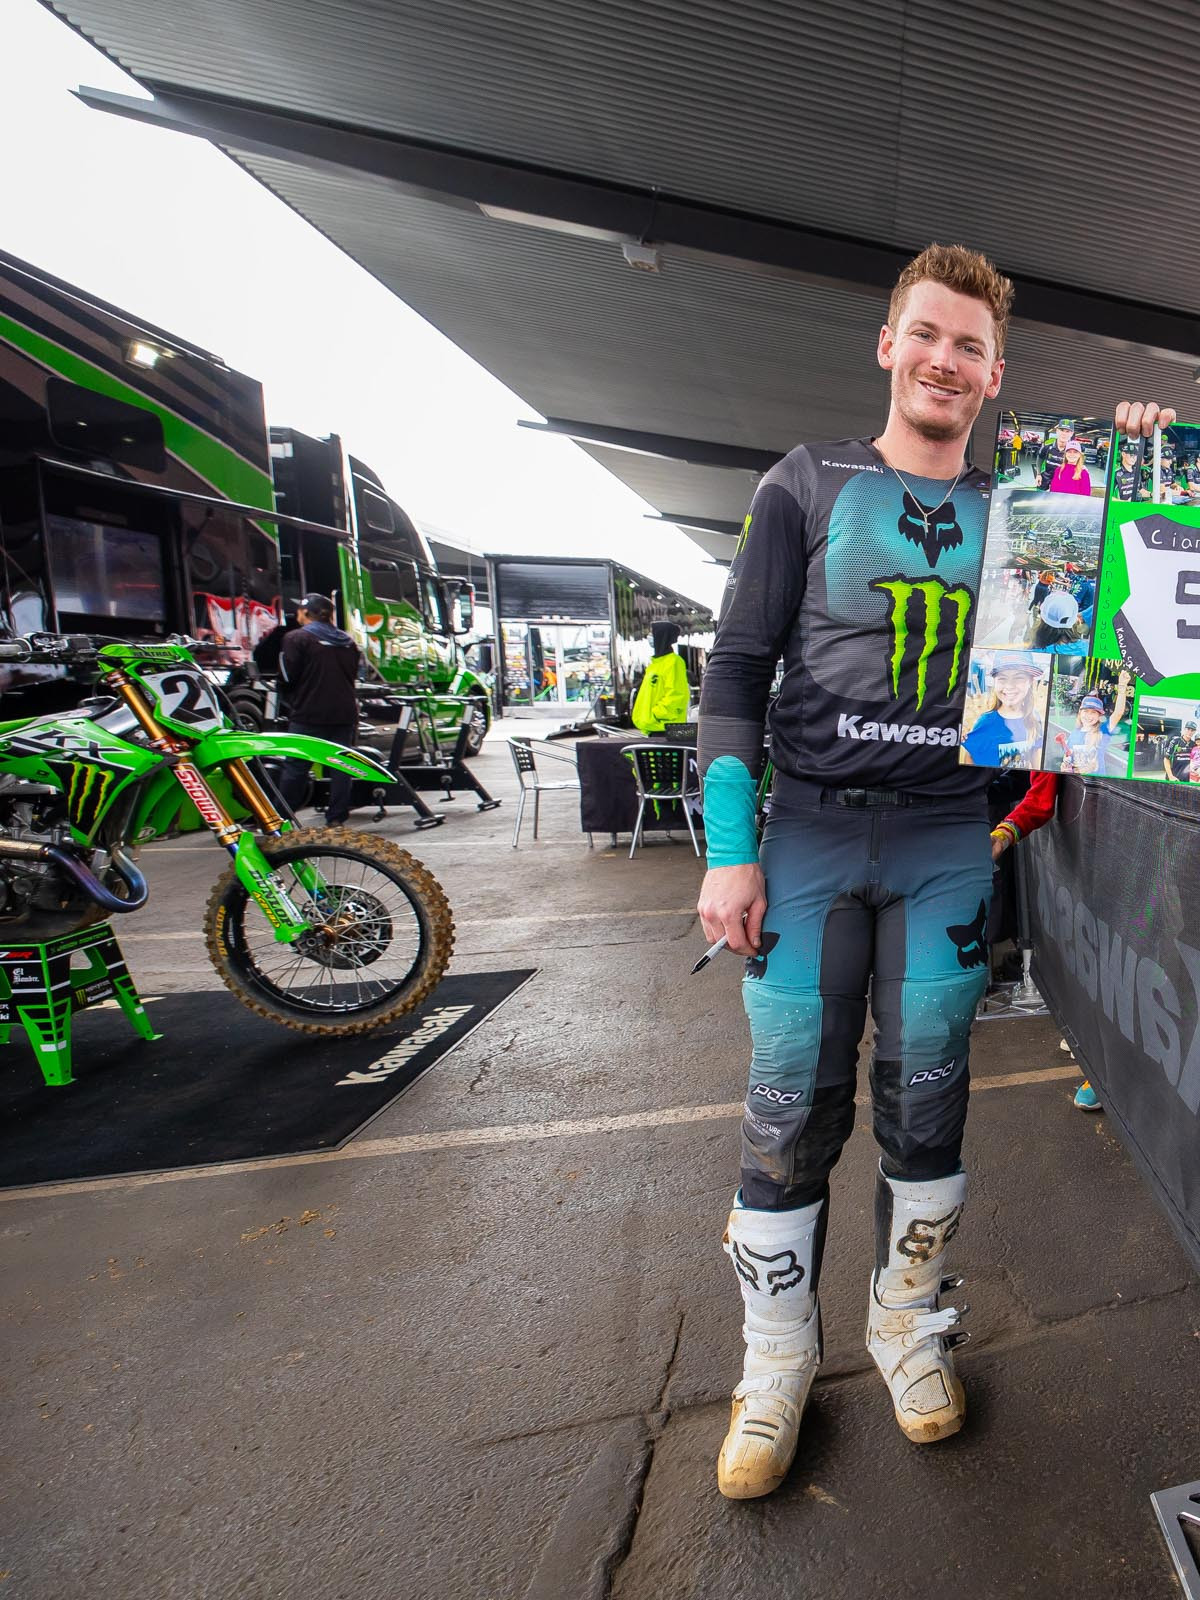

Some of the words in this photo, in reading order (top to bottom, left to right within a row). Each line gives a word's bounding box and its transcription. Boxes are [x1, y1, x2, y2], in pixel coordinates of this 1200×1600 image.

[821, 460, 885, 475] Kawasaki
[174, 768, 223, 824] SHOWA
[248, 868, 294, 928] DUNLOP
[334, 1004, 476, 1087] Kawasaki
